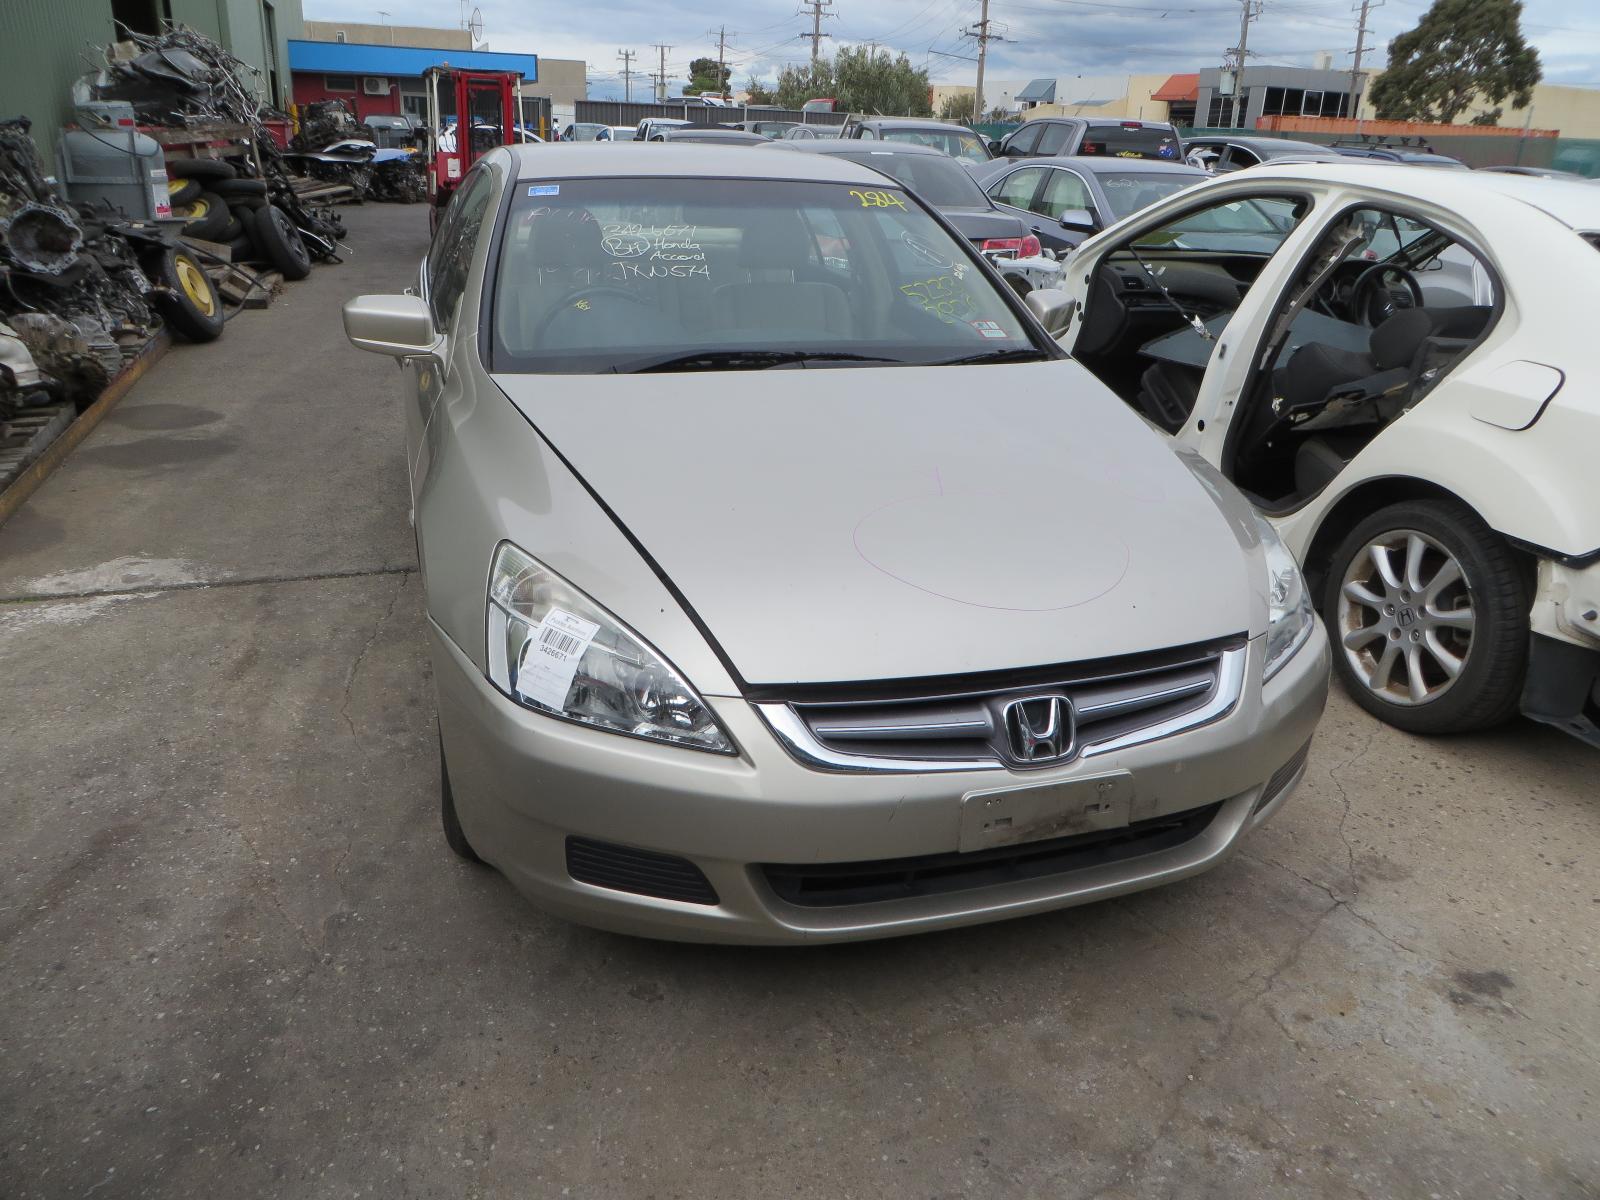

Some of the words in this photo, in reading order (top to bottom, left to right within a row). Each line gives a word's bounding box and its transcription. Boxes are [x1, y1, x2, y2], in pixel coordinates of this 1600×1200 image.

[850, 191, 908, 212] 284
[654, 238, 701, 250] Honda
[650, 251, 706, 261] Accord
[539, 644, 568, 662] 3426671
